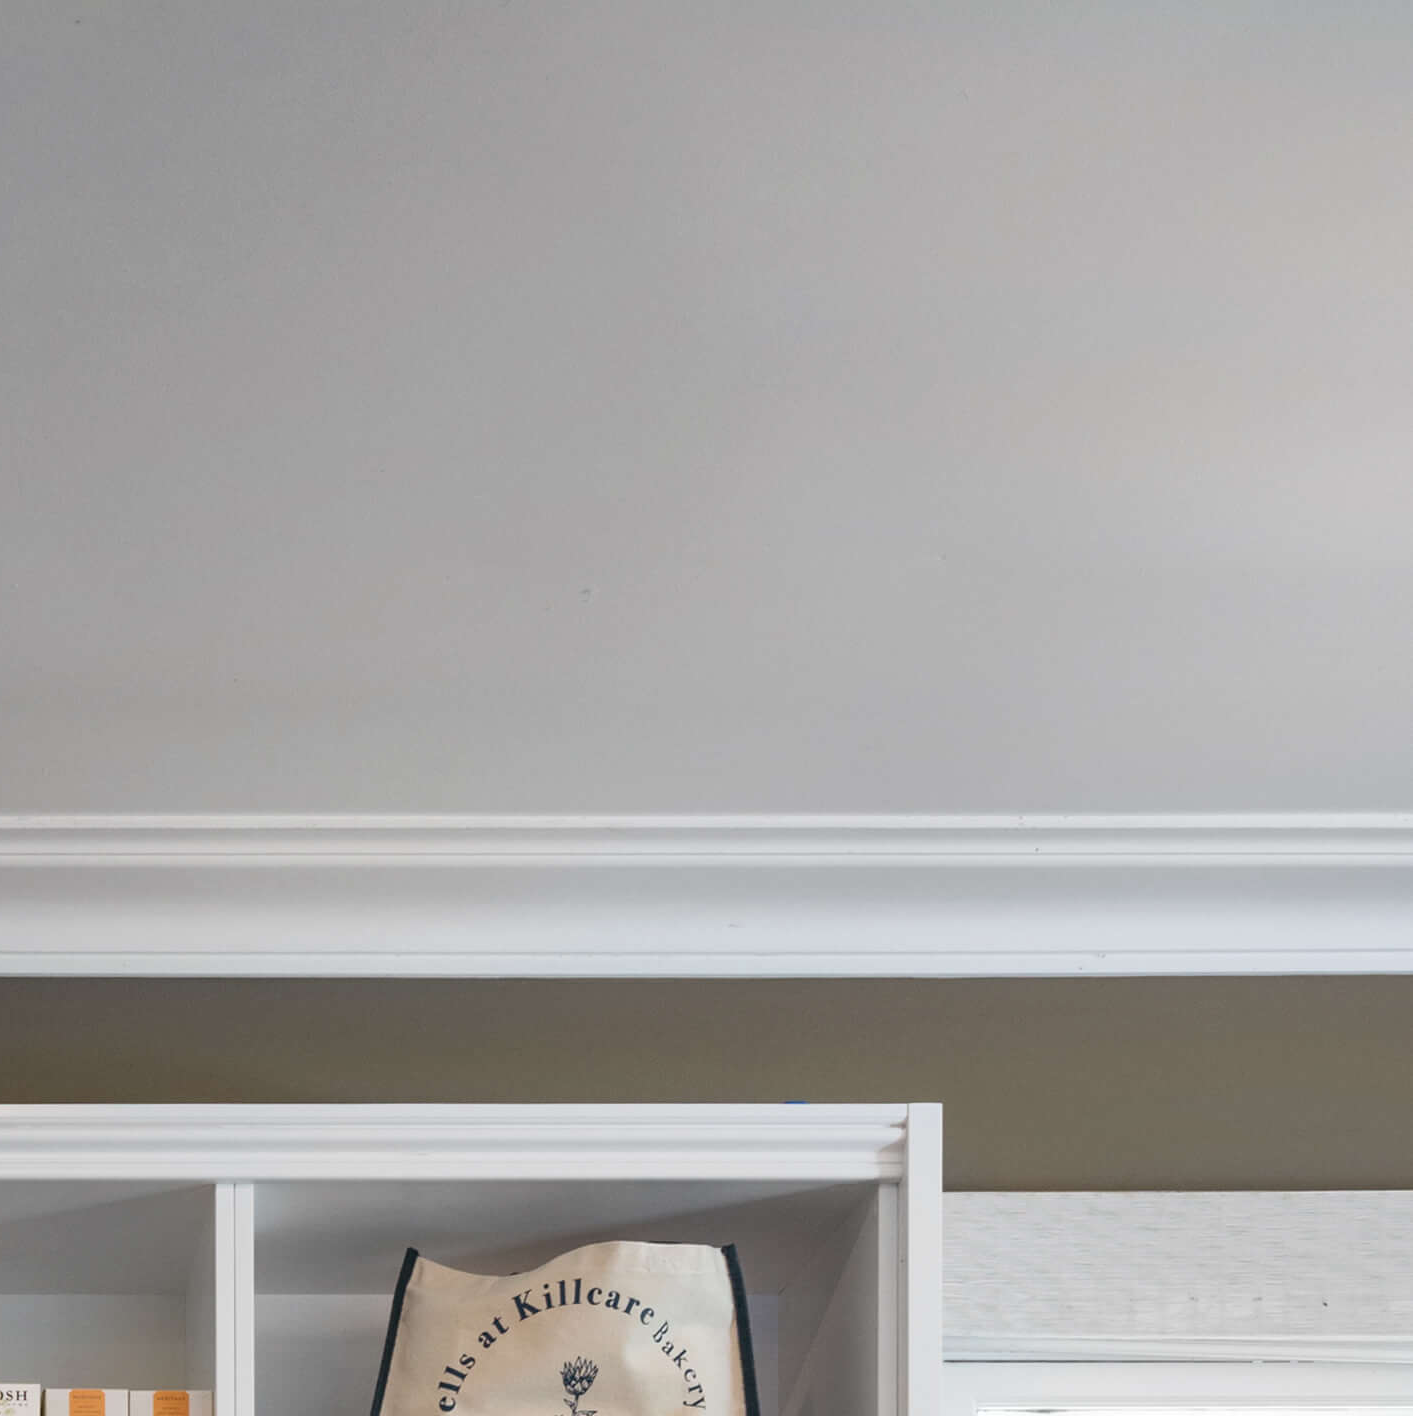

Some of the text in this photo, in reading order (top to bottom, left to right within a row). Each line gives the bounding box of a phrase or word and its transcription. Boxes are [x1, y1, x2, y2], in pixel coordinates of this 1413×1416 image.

[477, 1314, 509, 1349] at
[512, 1277, 657, 1328] Killcare
[652, 1320, 707, 1410] Bakery
